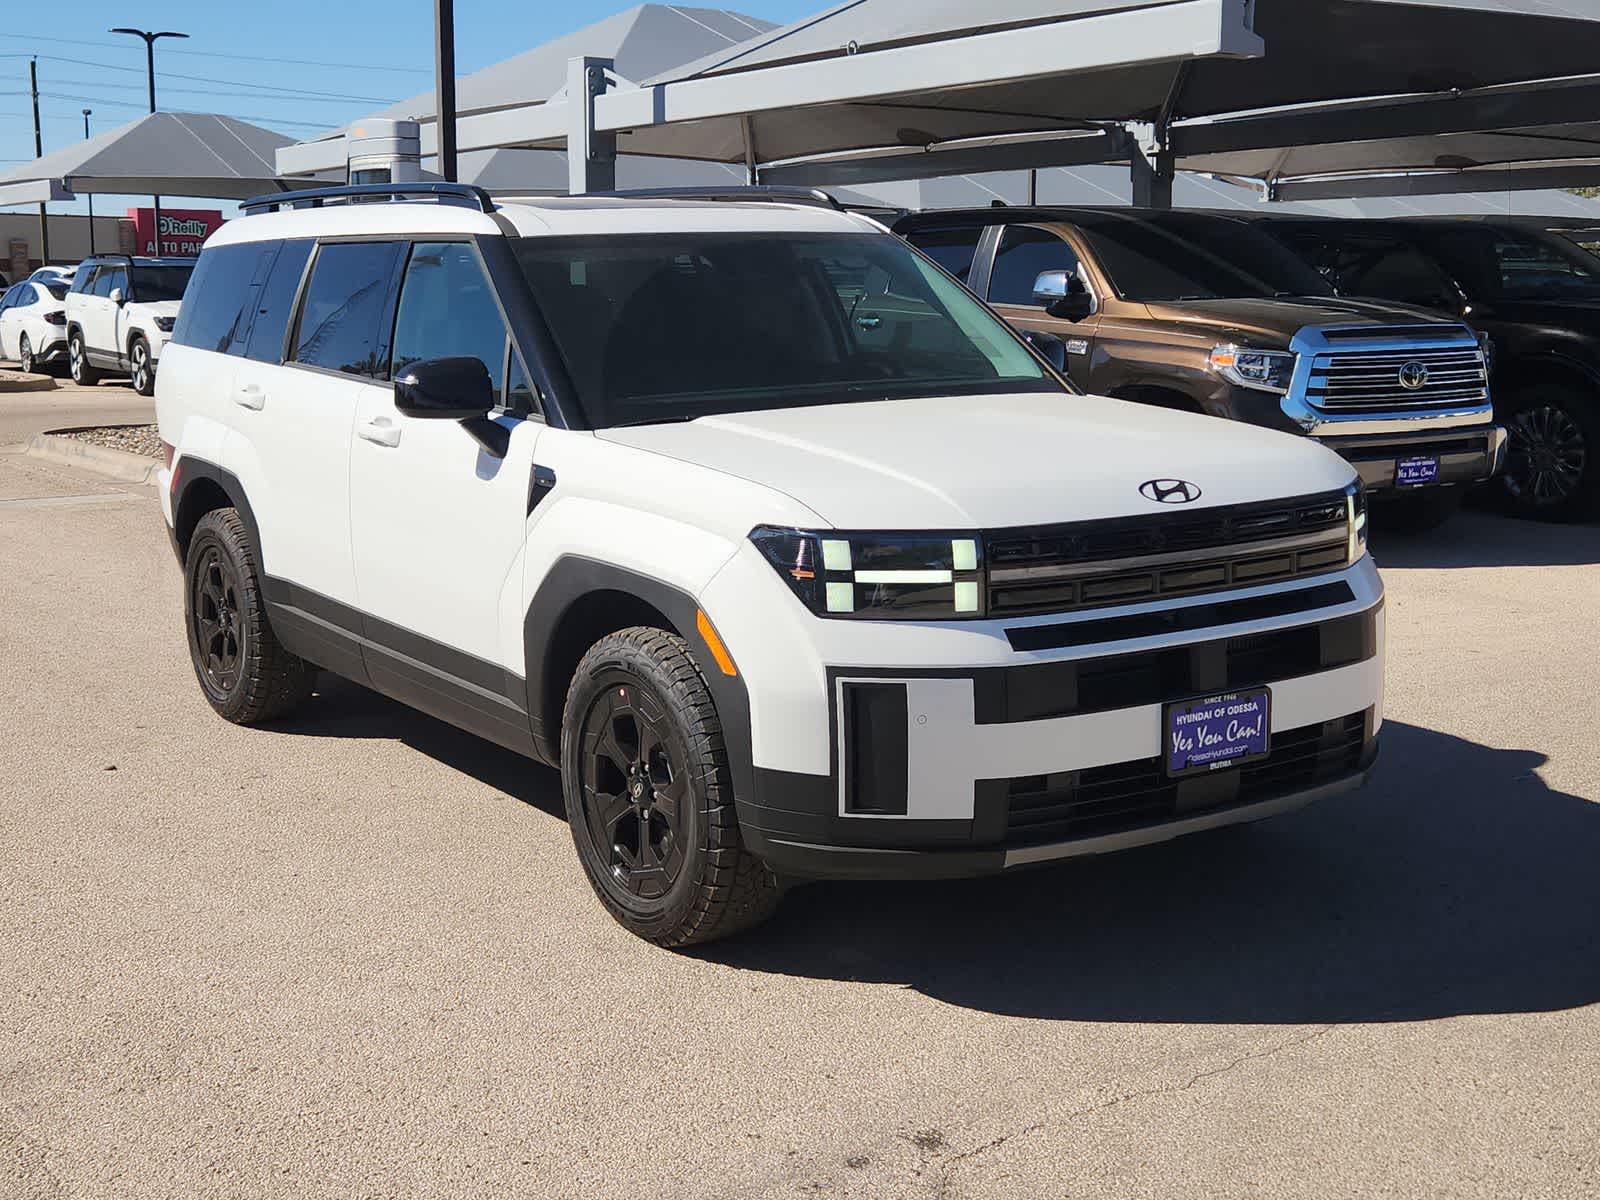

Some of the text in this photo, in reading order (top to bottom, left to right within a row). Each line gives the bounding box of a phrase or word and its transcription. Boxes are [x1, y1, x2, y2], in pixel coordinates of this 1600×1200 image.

[146, 241, 178, 253] ATO
[1176, 701, 1259, 725] HYUNDAI OF ODESSA
[1172, 714, 1263, 754] Yes You Can!
